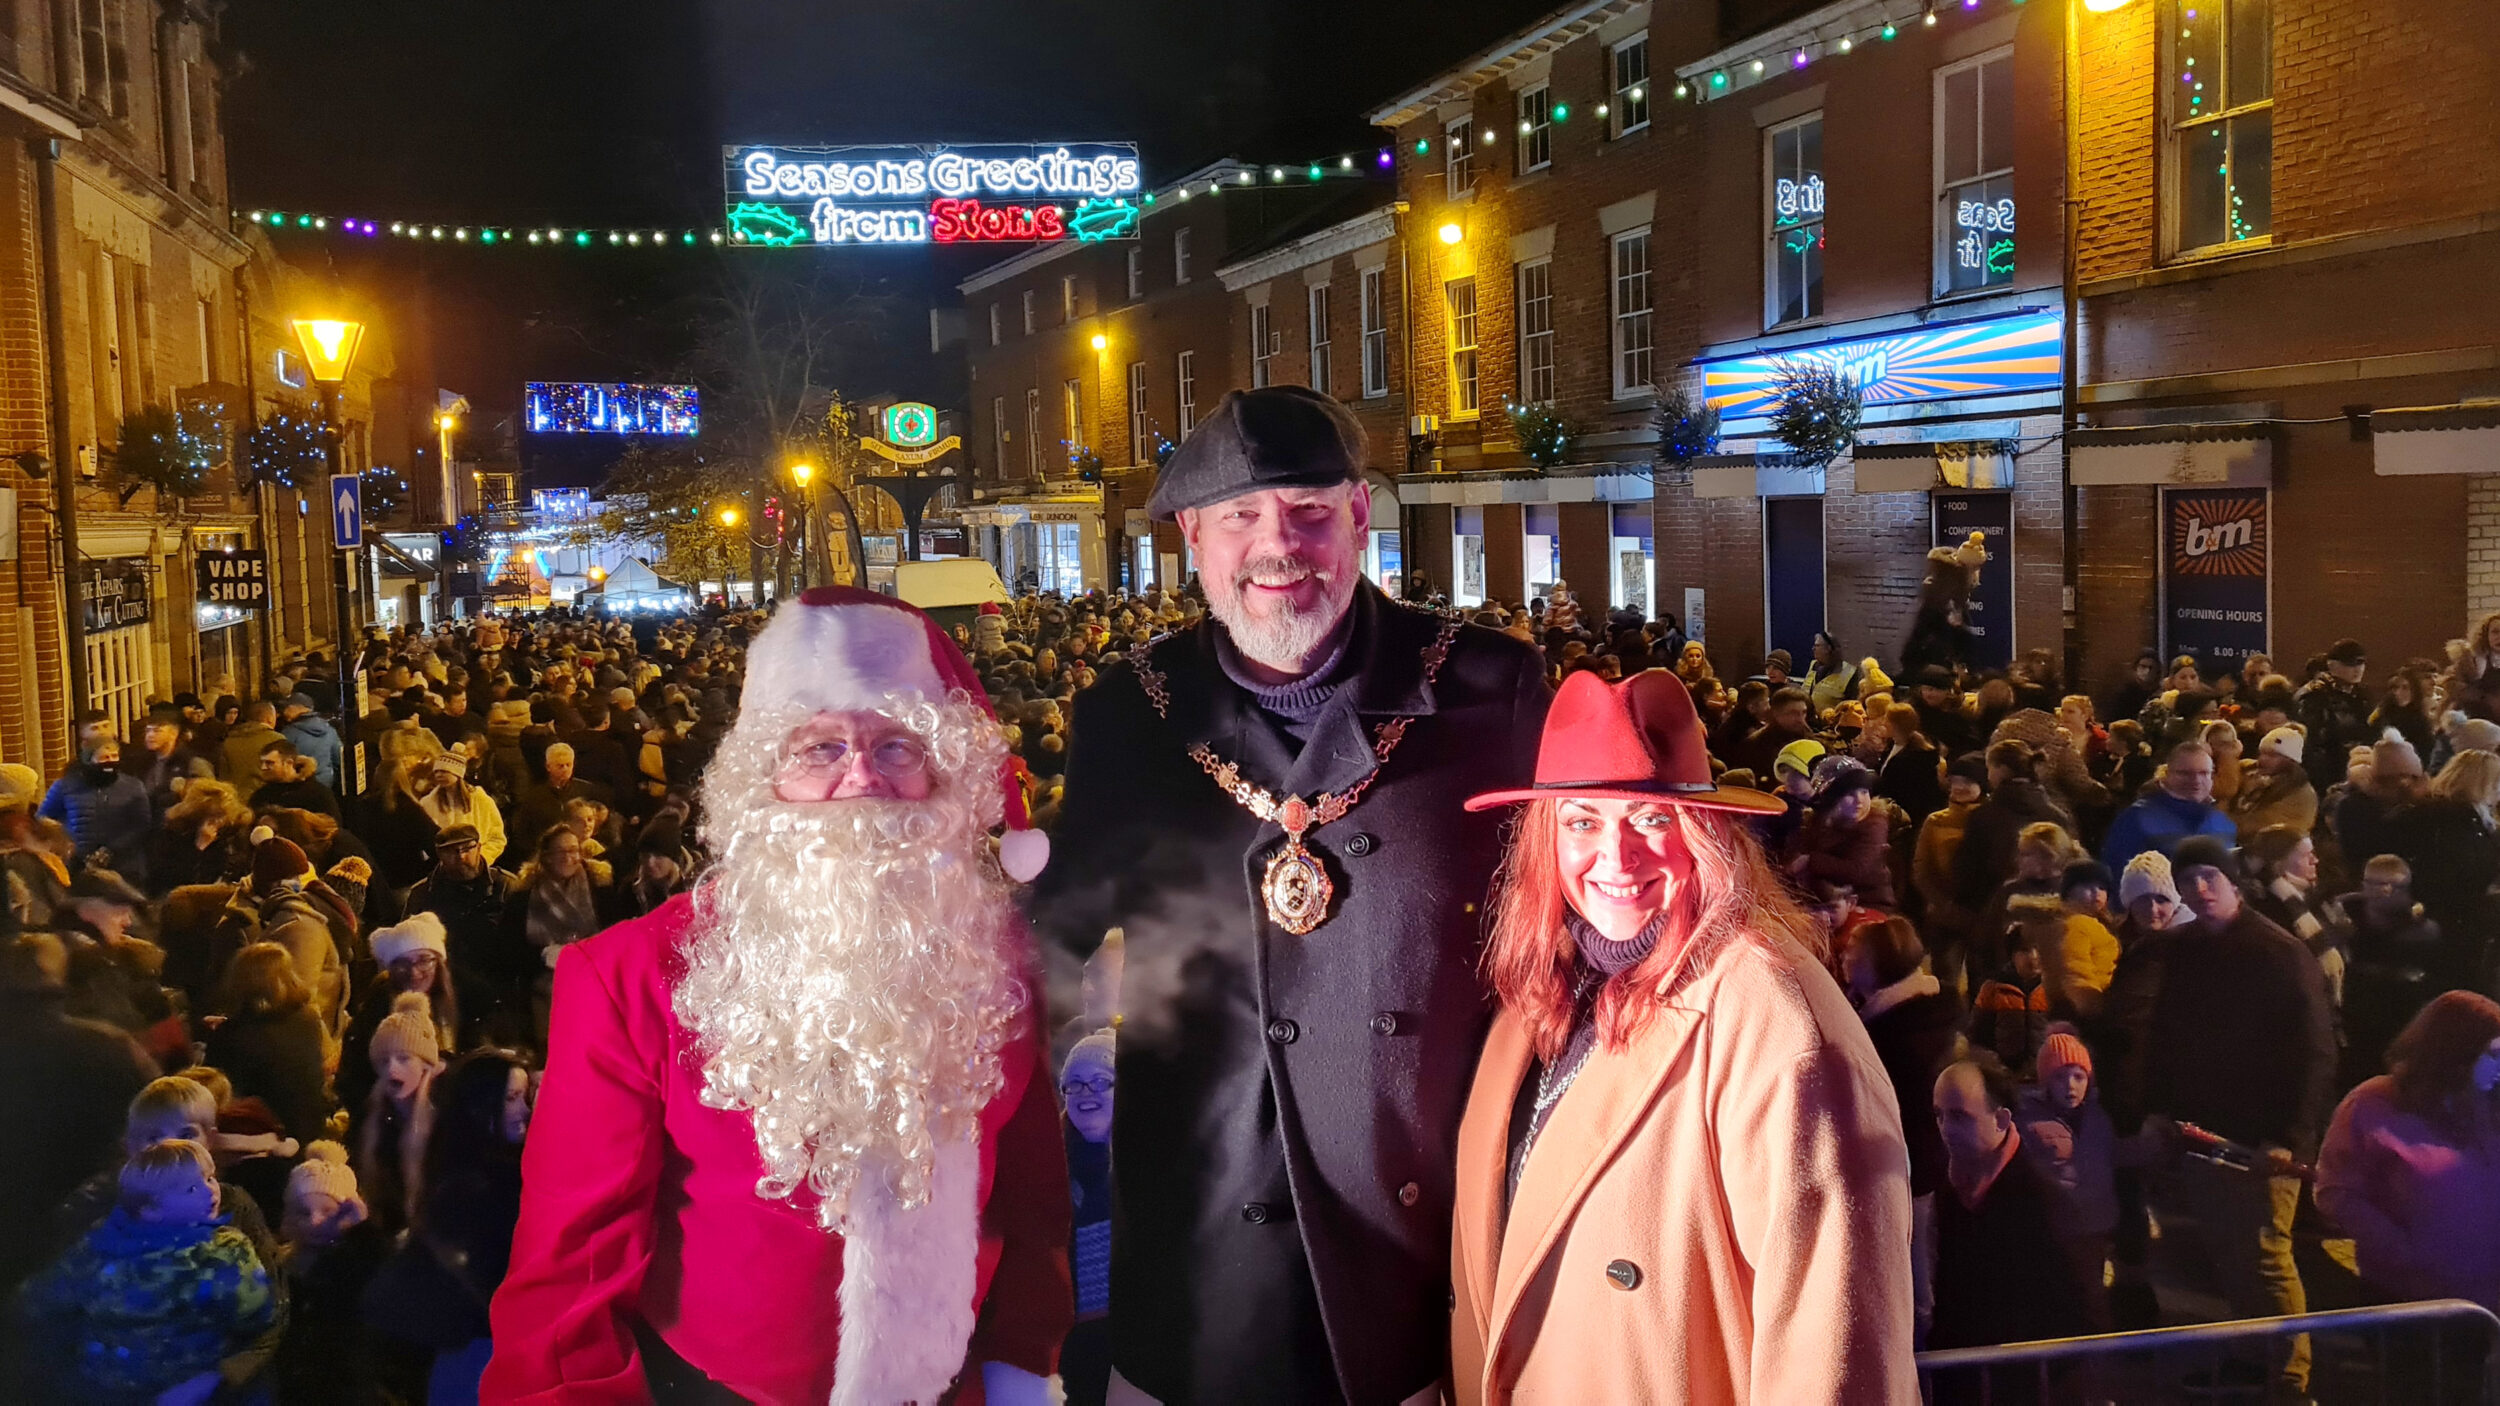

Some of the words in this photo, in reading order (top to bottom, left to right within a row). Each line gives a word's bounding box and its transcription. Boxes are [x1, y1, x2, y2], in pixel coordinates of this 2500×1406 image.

[744, 151, 926, 197] Seasons
[928, 148, 1140, 197] Greetings
[810, 197, 927, 242] from
[930, 197, 1065, 242] Stone
[1948, 502, 1968, 511] FOOD
[2185, 518, 2252, 556] b&m
[208, 560, 263, 578] VAPE
[209, 582, 264, 601] SHOP
[2177, 608, 2223, 621] OPENING
[2226, 611, 2263, 623] HOURS
[2214, 647, 2234, 657] 8.00
